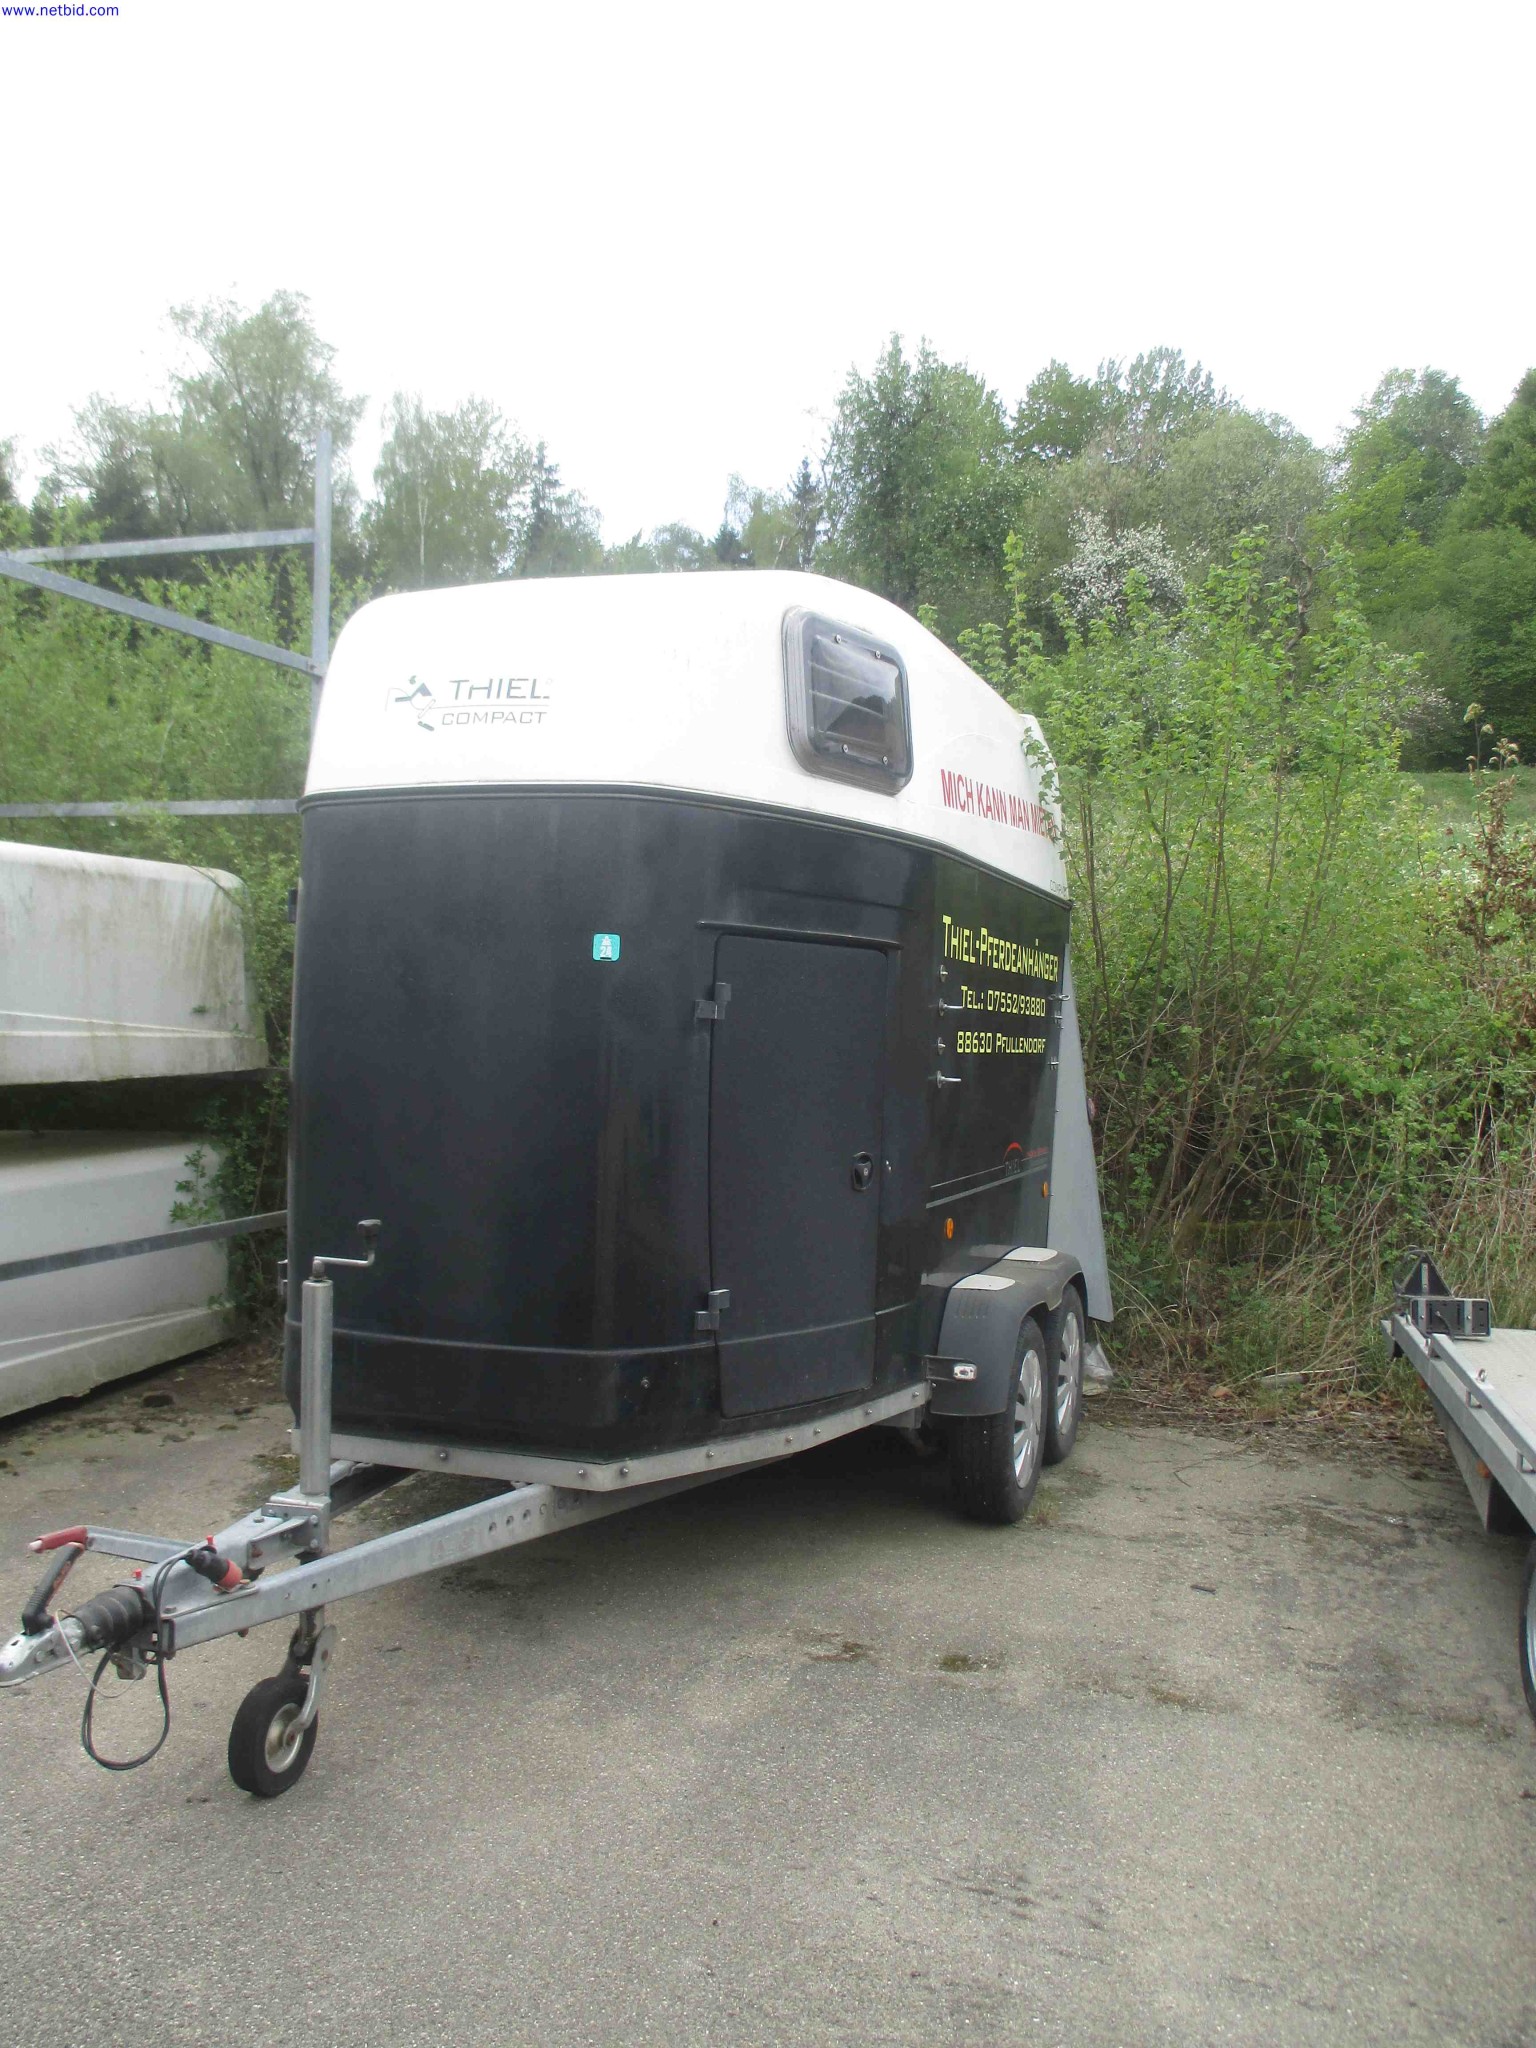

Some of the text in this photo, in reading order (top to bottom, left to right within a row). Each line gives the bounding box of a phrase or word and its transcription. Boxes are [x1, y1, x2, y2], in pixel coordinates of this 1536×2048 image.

[449, 678, 551, 701] THIEL
[441, 711, 548, 725] COMPACT
[940, 768, 975, 815] MICH
[976, 781, 1008, 825] KANN
[1008, 793, 1030, 831] MAN
[987, 989, 1046, 1017] 07552/93880
[956, 1031, 1047, 1053] 88630 PFULLENDORF
